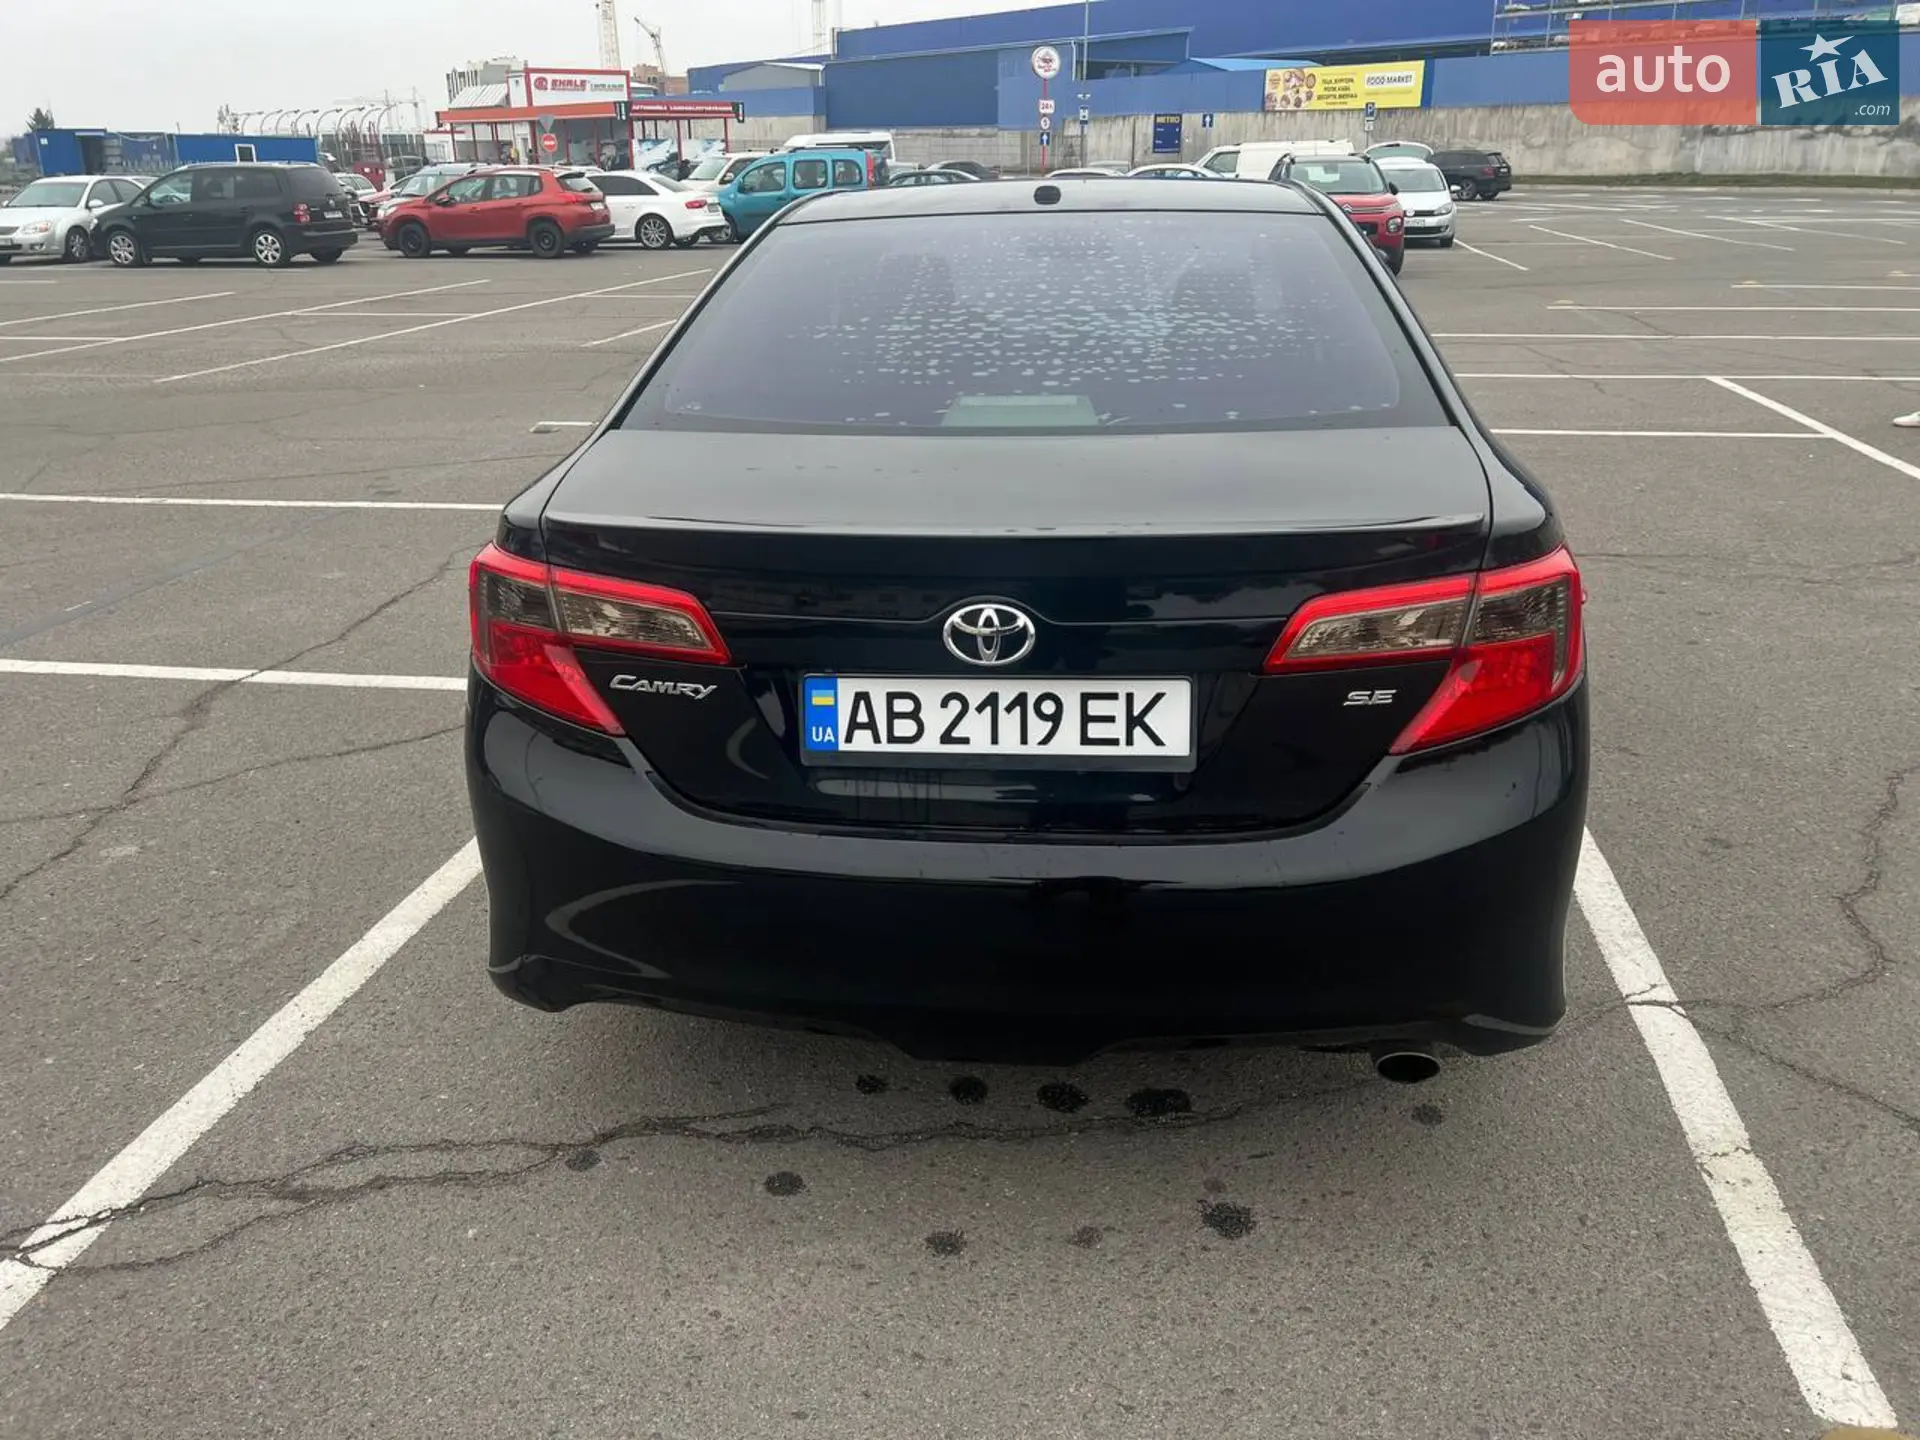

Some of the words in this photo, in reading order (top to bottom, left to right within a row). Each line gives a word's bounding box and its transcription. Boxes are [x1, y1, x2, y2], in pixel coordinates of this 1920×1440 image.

[1156, 116, 1180, 124] METRO
[609, 673, 718, 700] CAMRY
[1343, 689, 1398, 706] SE
[843, 690, 925, 745] AB
[939, 690, 1064, 746] 2119
[1079, 691, 1167, 747] EK
[811, 726, 835, 743] UA
